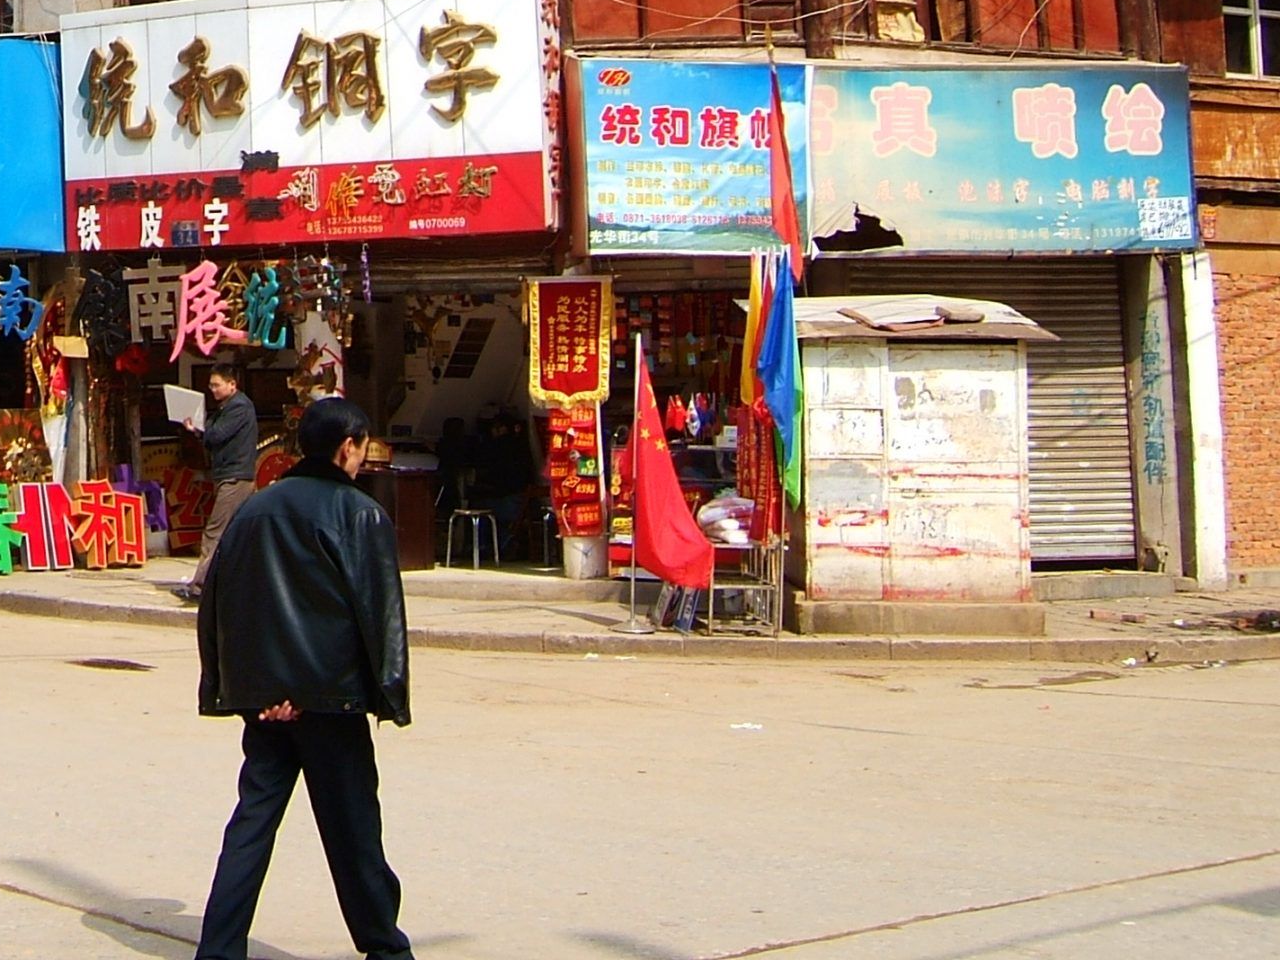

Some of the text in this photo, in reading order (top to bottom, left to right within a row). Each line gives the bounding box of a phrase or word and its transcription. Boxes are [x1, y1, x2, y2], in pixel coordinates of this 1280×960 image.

[84, 8, 501, 141] 统和铜字
[1012, 82, 1166, 159] 喷绘
[77, 198, 229, 251] 铁皮字
[122, 257, 186, 343] 南
[556, 296, 571, 332] 为民服务
[574, 296, 588, 332] 以人为本
[71, 479, 147, 569] 和
